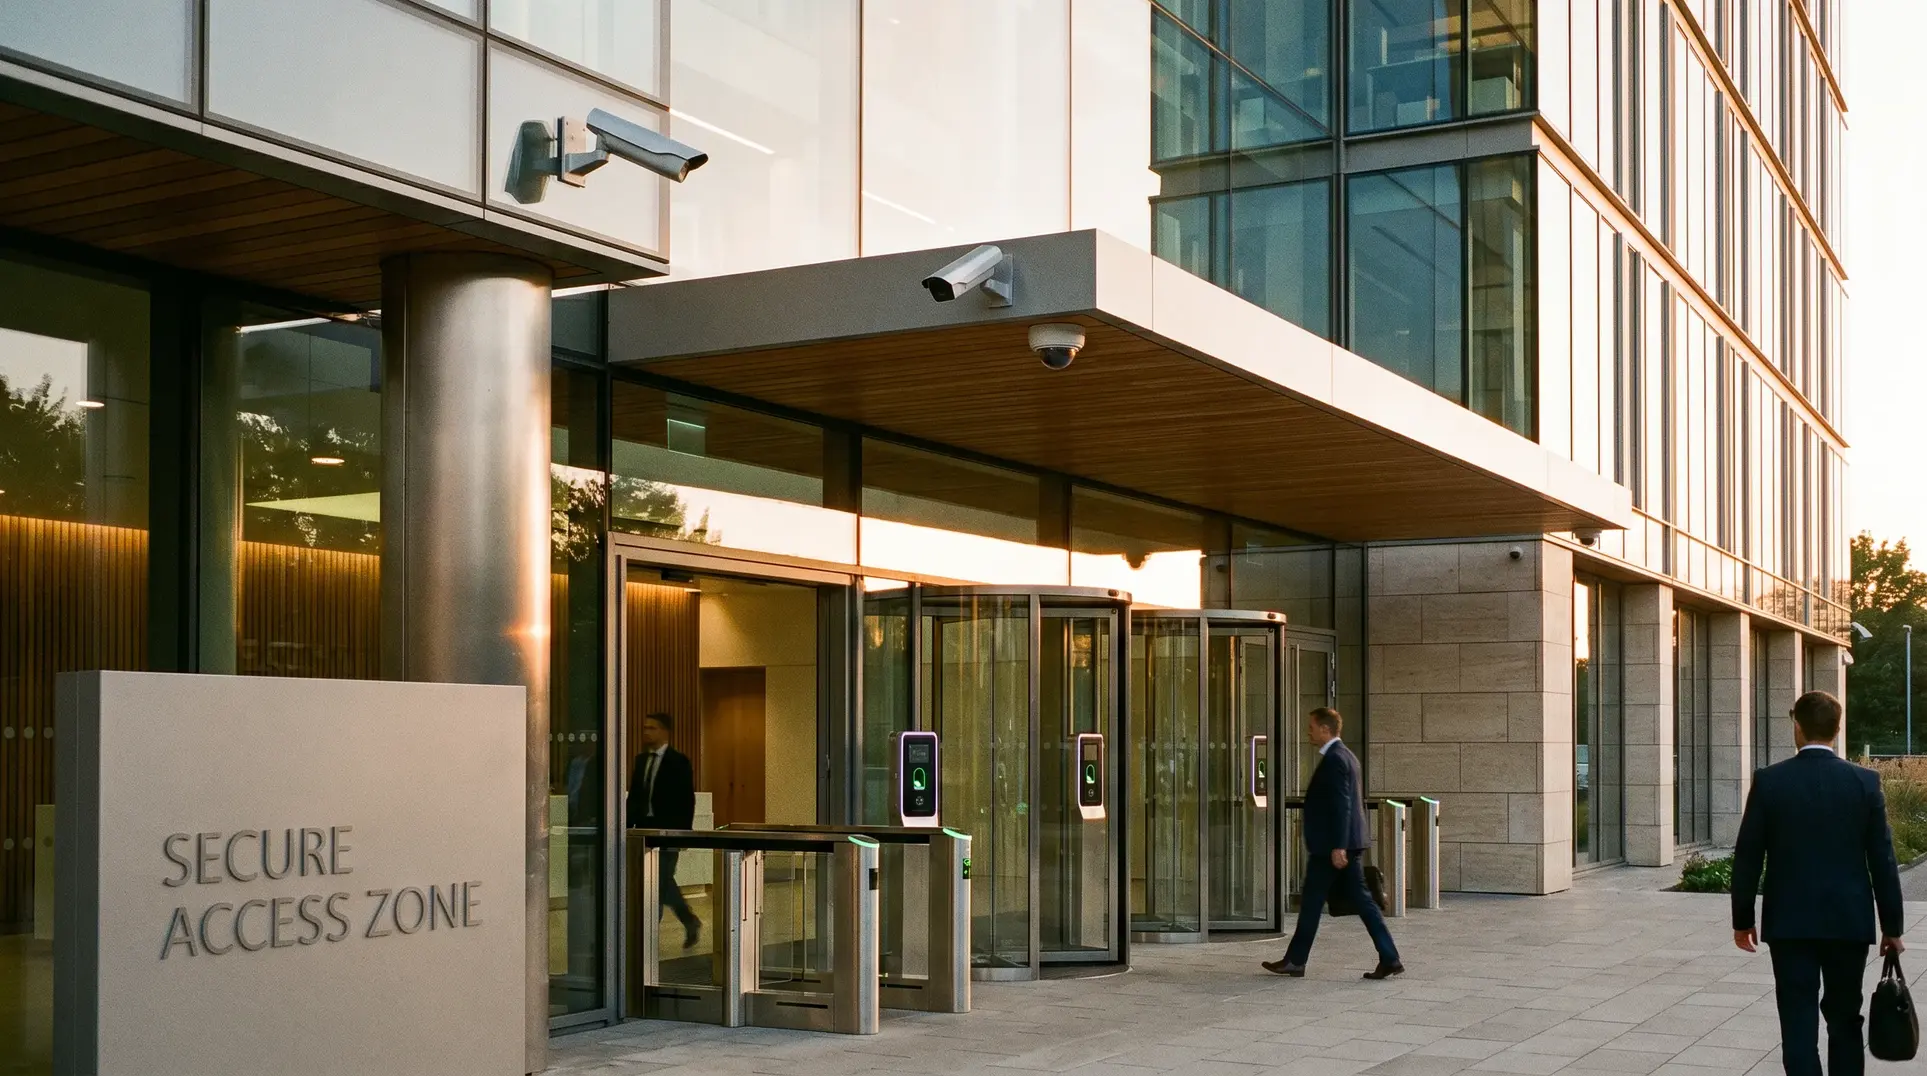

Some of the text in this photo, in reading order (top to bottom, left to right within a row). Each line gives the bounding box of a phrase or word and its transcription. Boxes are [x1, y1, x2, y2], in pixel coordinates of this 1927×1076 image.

[163, 826, 354, 887] SECURE
[160, 881, 483, 960] ACCESS ZONE
